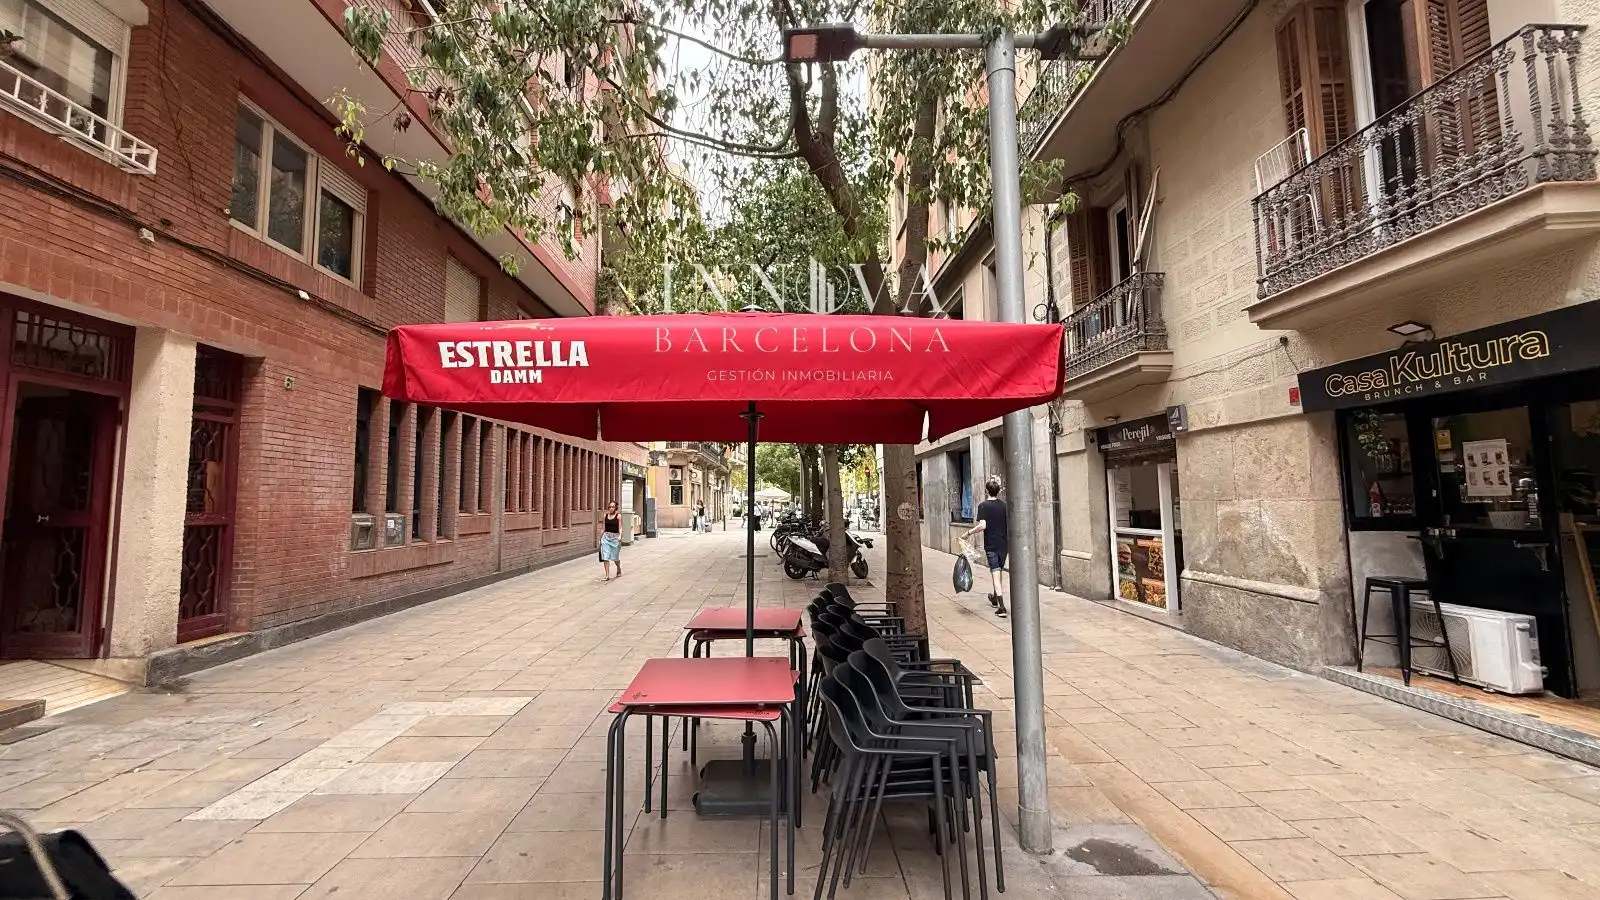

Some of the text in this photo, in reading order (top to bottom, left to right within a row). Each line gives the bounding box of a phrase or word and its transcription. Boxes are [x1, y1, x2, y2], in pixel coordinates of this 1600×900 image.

[437, 340, 590, 369] ESTRELLA
[490, 369, 543, 384] DAMM
[1364, 371, 1488, 401] BRUNCH & BAR
[1122, 423, 1150, 443] Perejil
